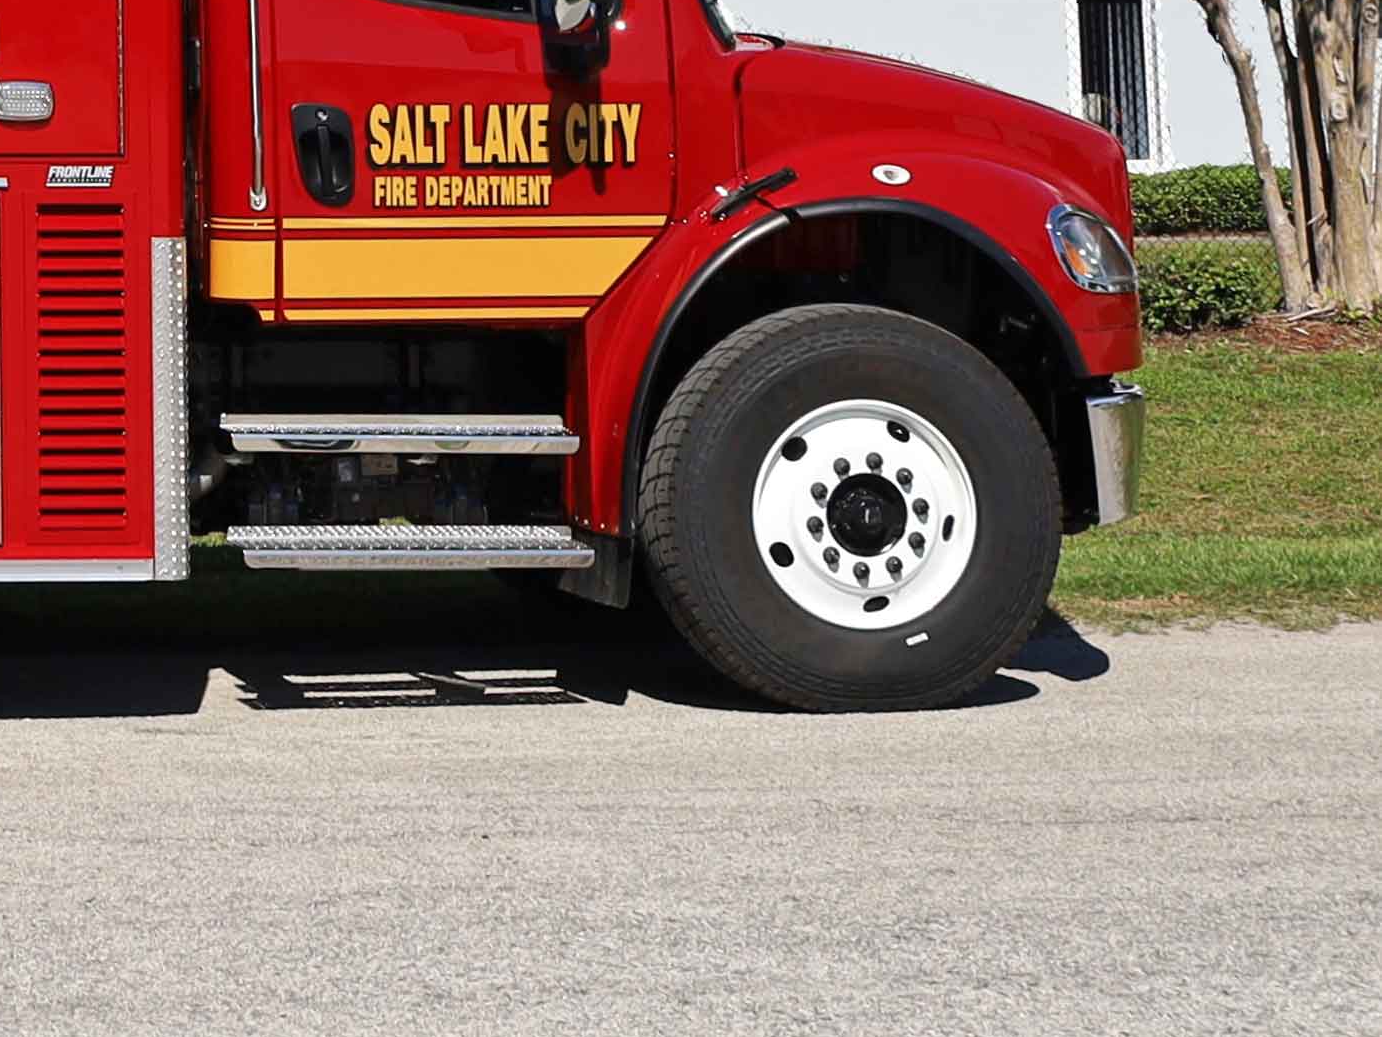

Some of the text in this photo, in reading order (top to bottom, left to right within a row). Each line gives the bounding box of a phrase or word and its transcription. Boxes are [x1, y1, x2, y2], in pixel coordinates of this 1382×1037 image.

[369, 102, 642, 166] SALT LAKE CITY
[47, 165, 115, 178] FRONTLINE
[374, 175, 552, 208] FIRE DEPARTMENT
